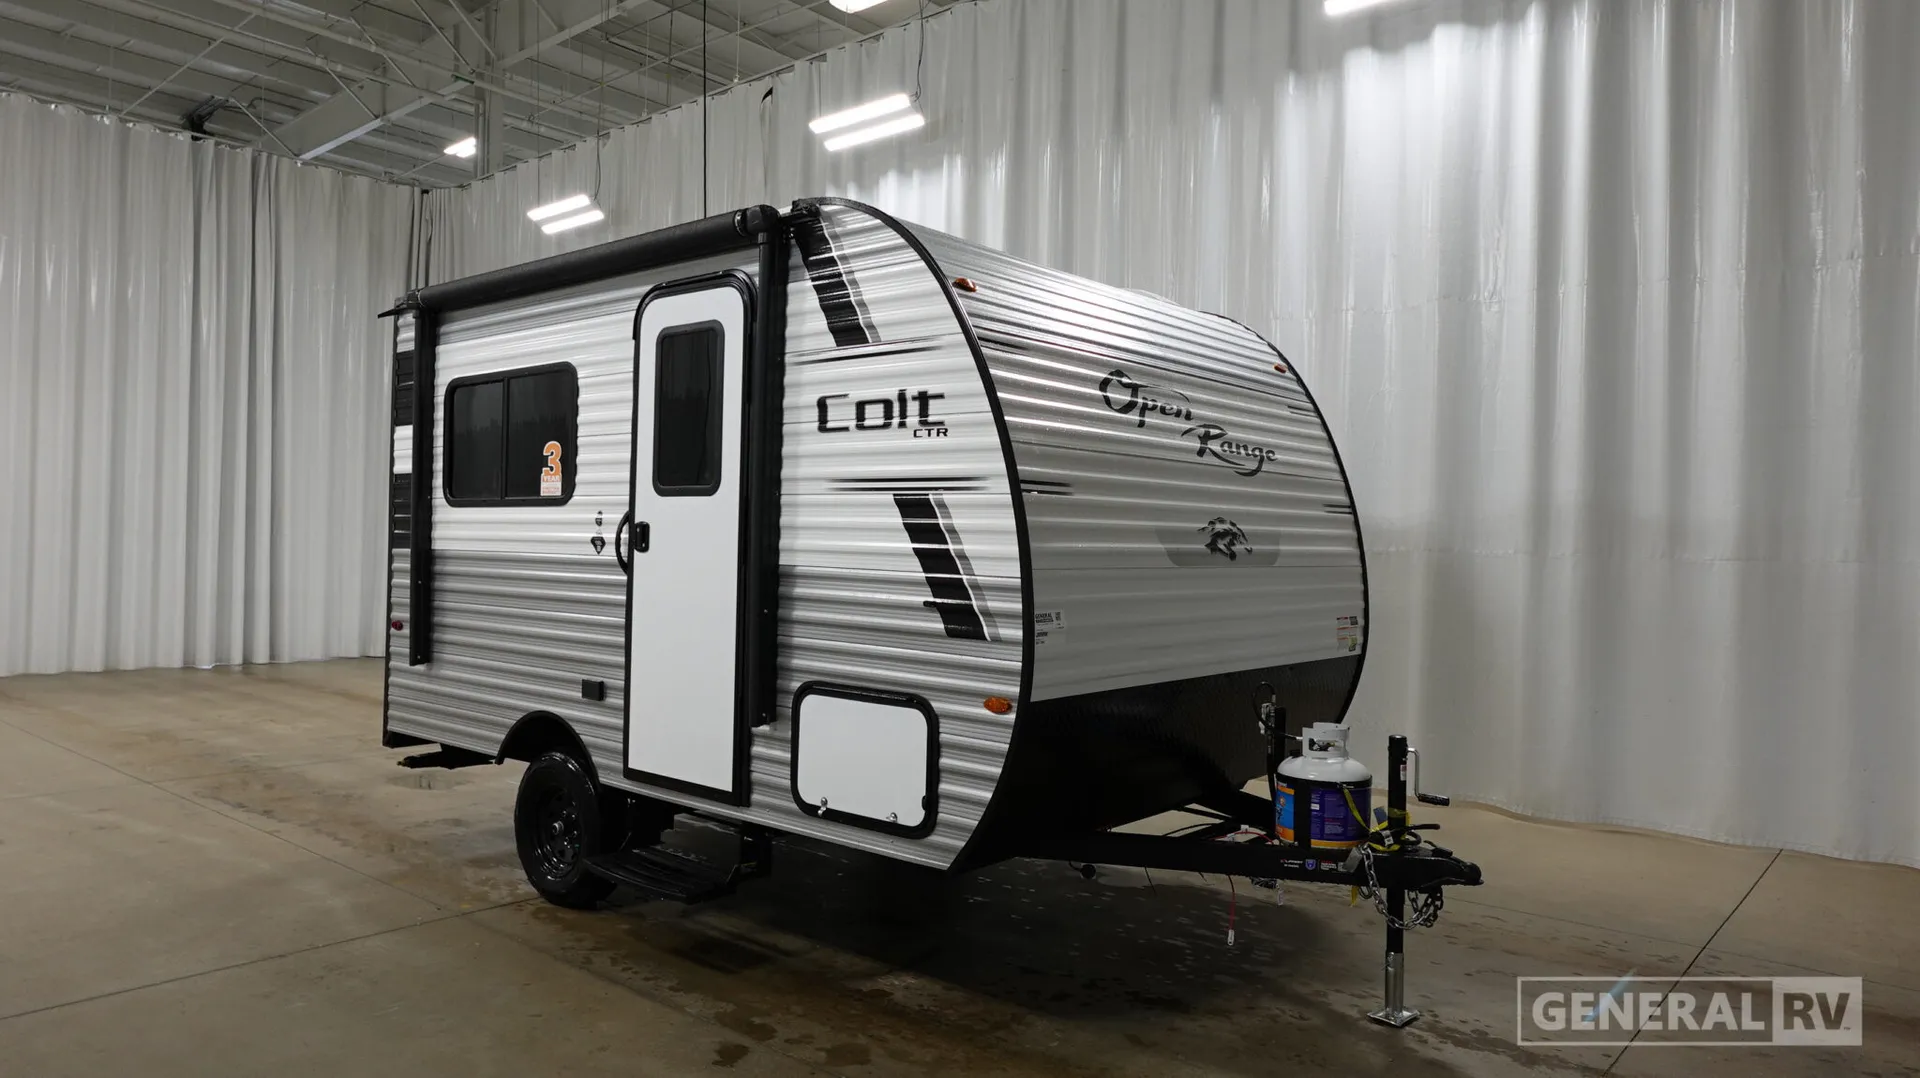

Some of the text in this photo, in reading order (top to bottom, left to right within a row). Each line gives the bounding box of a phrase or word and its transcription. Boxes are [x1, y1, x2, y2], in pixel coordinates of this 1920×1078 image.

[816, 388, 946, 433] Colt
[1098, 369, 1194, 428] Open
[913, 427, 949, 438] CTR
[1180, 423, 1278, 477] Range
[543, 441, 562, 475] 3
